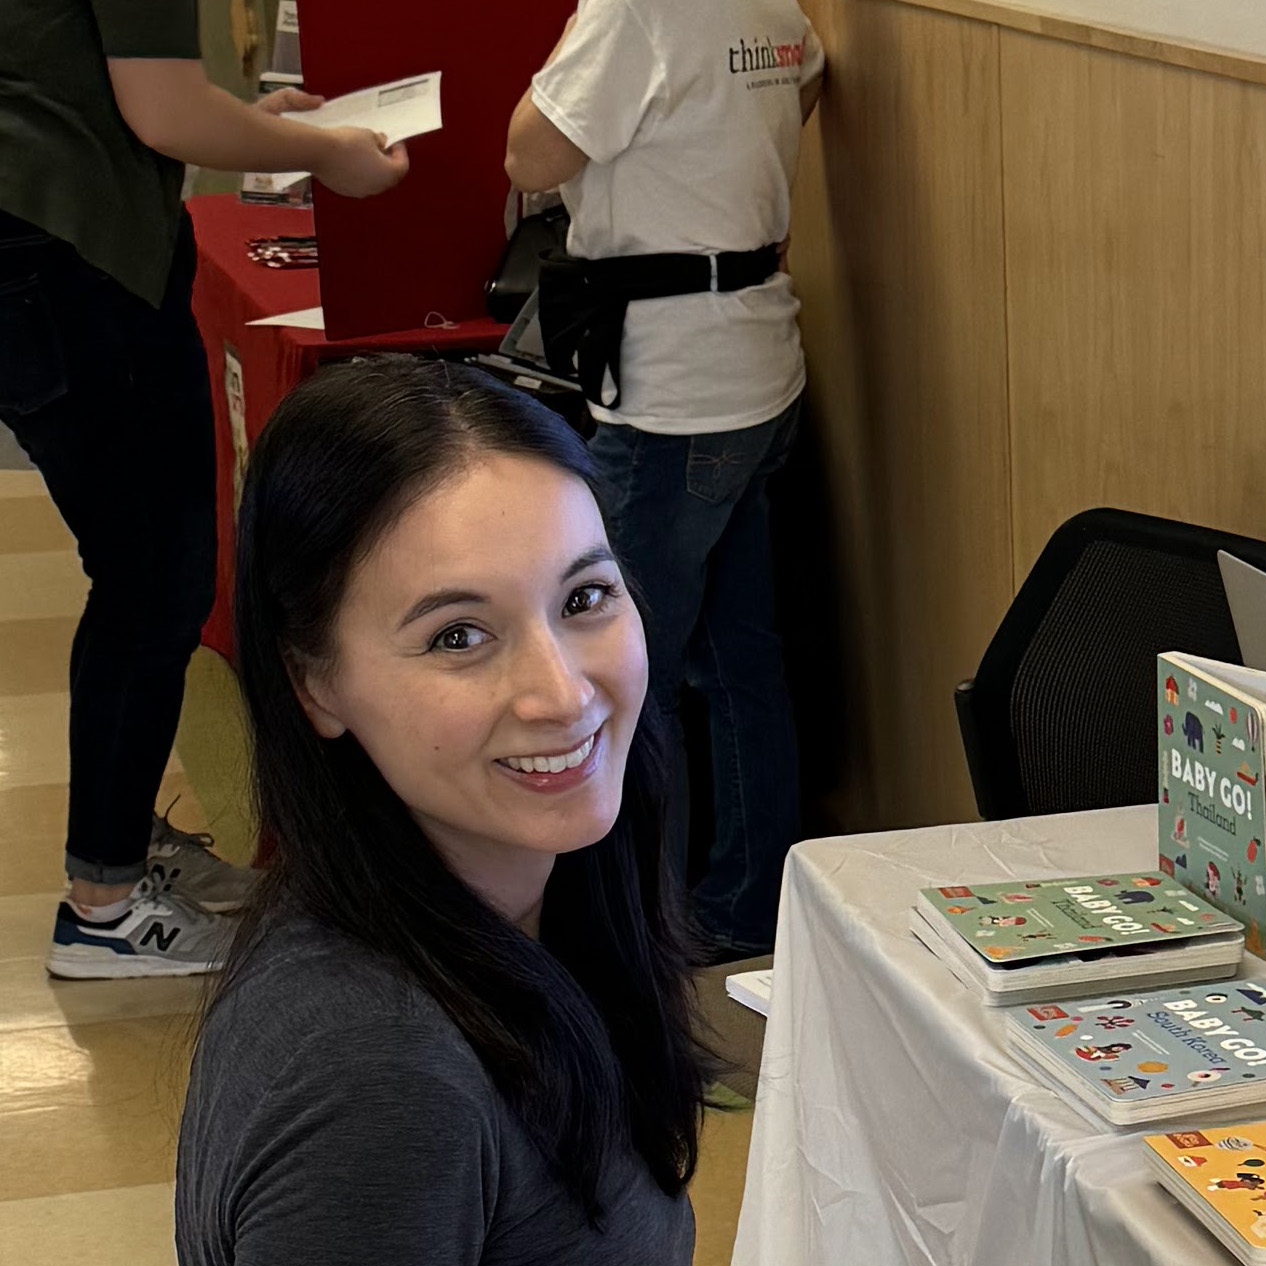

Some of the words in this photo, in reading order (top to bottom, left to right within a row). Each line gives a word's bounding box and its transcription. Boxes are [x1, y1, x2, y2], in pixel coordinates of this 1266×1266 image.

[1171, 748, 1216, 798] BABY
[1220, 777, 1252, 820] GO!
[1188, 792, 1236, 835] Thailand
[1063, 885, 1123, 914] BABY
[1102, 915, 1151, 936] GO!
[140, 922, 181, 951] N
[1163, 999, 1240, 1035] BABY
